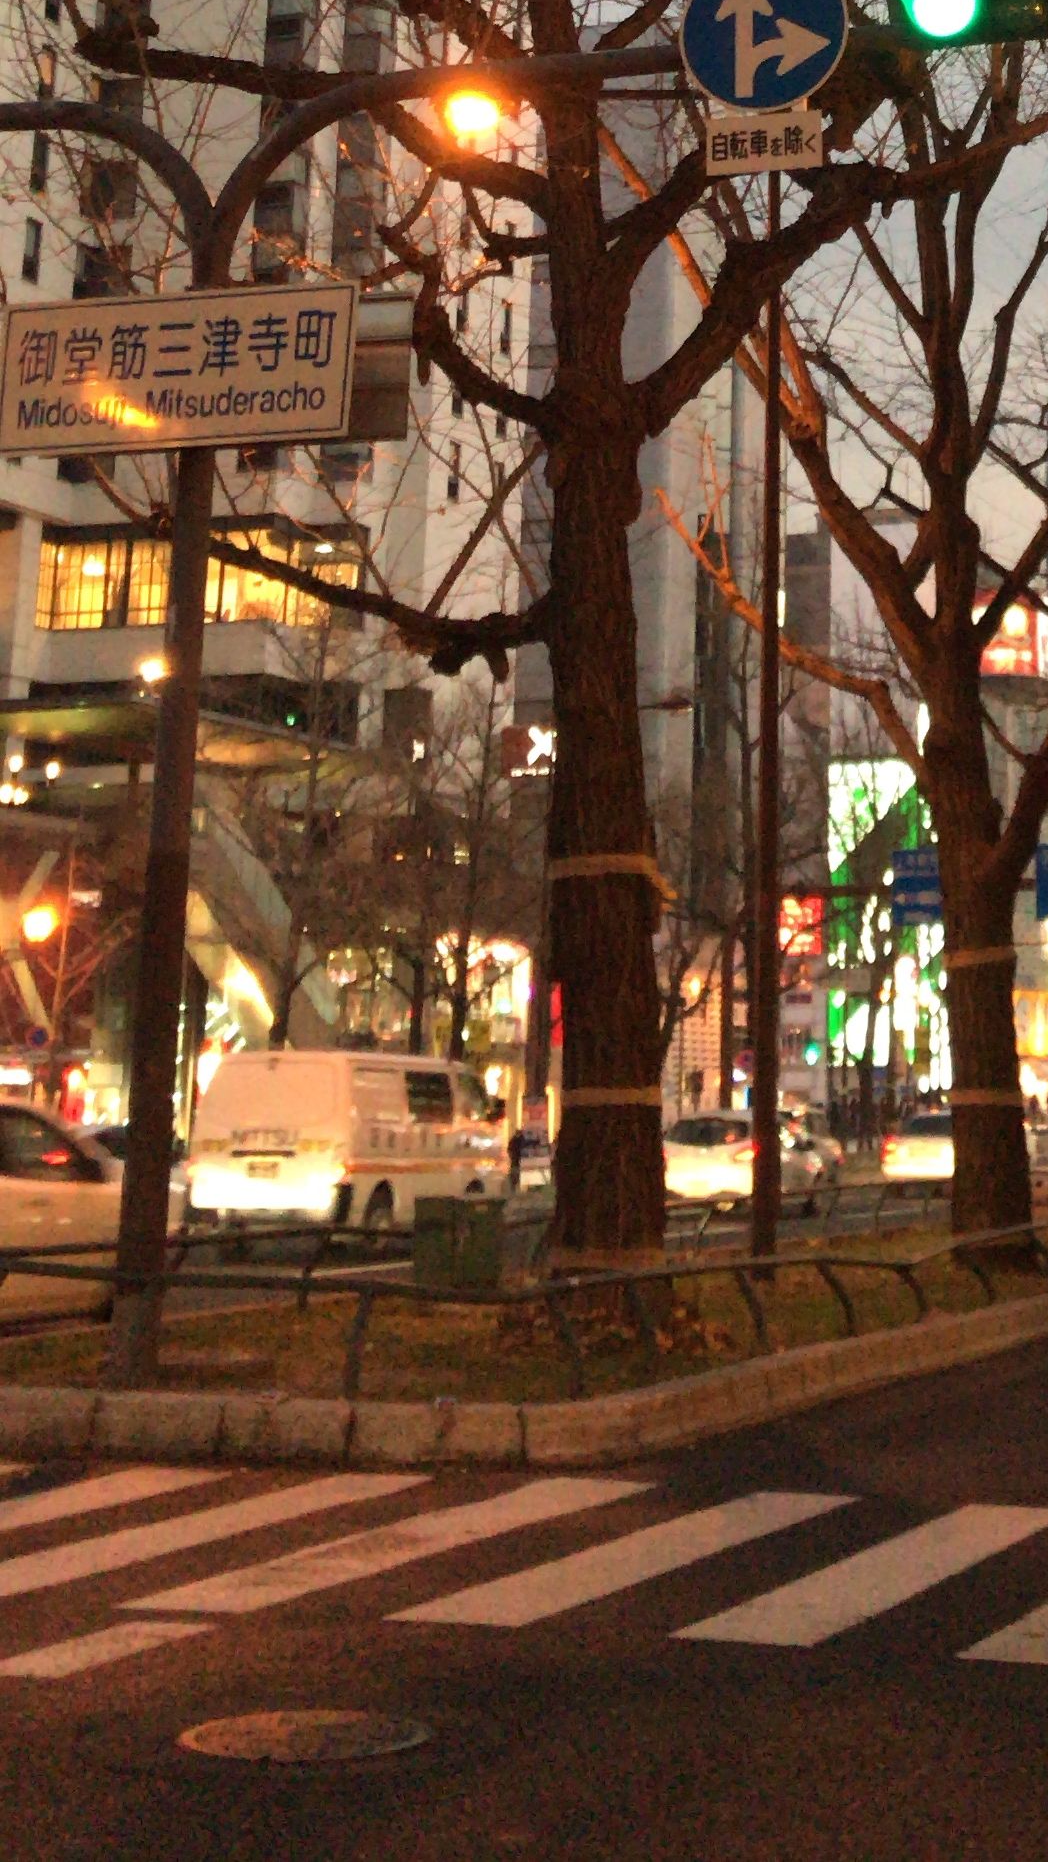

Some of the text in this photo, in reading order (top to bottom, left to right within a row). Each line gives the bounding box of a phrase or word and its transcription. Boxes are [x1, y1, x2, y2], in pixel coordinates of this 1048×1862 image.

[711, 126, 817, 162] 自転車を除く
[17, 309, 338, 387] 御堂筋三津寺町
[145, 384, 326, 421] Mitsuderacho
